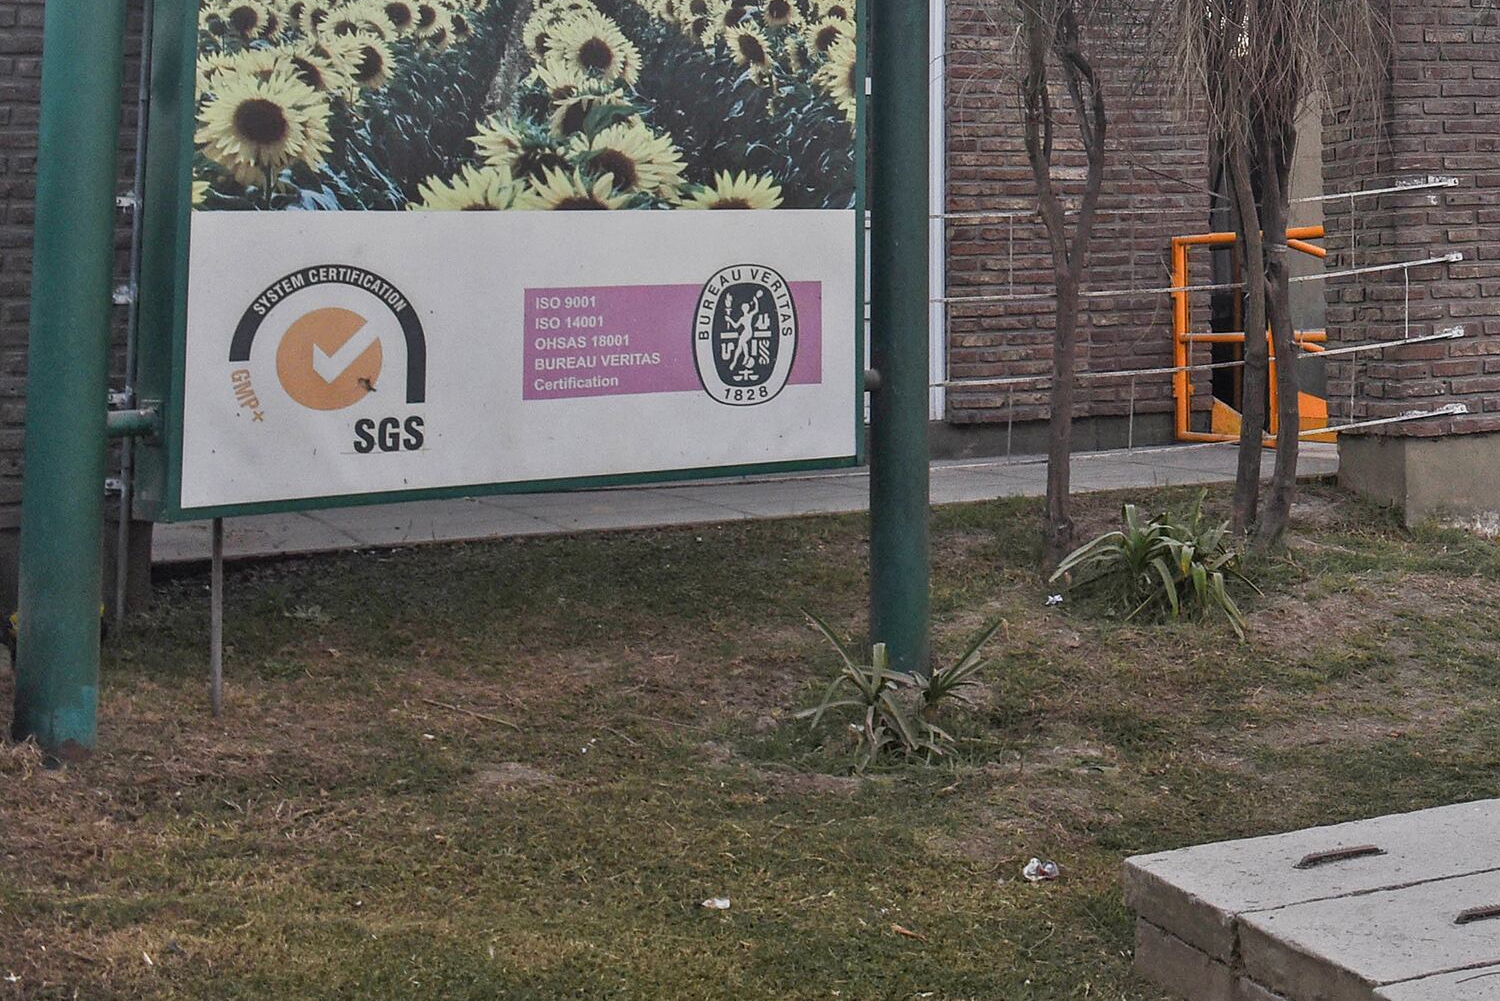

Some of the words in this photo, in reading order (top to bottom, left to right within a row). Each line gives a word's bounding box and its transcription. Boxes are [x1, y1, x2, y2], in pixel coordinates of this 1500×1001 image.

[253, 273, 306, 316] SYSTEM
[308, 267, 407, 313] CERTIFICATION
[535, 297, 561, 310] ISO
[564, 296, 597, 308] 9001
[699, 269, 742, 341] BUREAU
[750, 269, 793, 338] VERITAS
[535, 317, 561, 330] ISO
[566, 315, 604, 328] 14001
[534, 336, 587, 350] OHSAS
[591, 334, 630, 348] 18001
[534, 356, 597, 370] BUREAU
[600, 352, 661, 367] VERITAS
[534, 374, 619, 391] Certification
[724, 385, 769, 402] 1828
[353, 416, 424, 454] SGS
